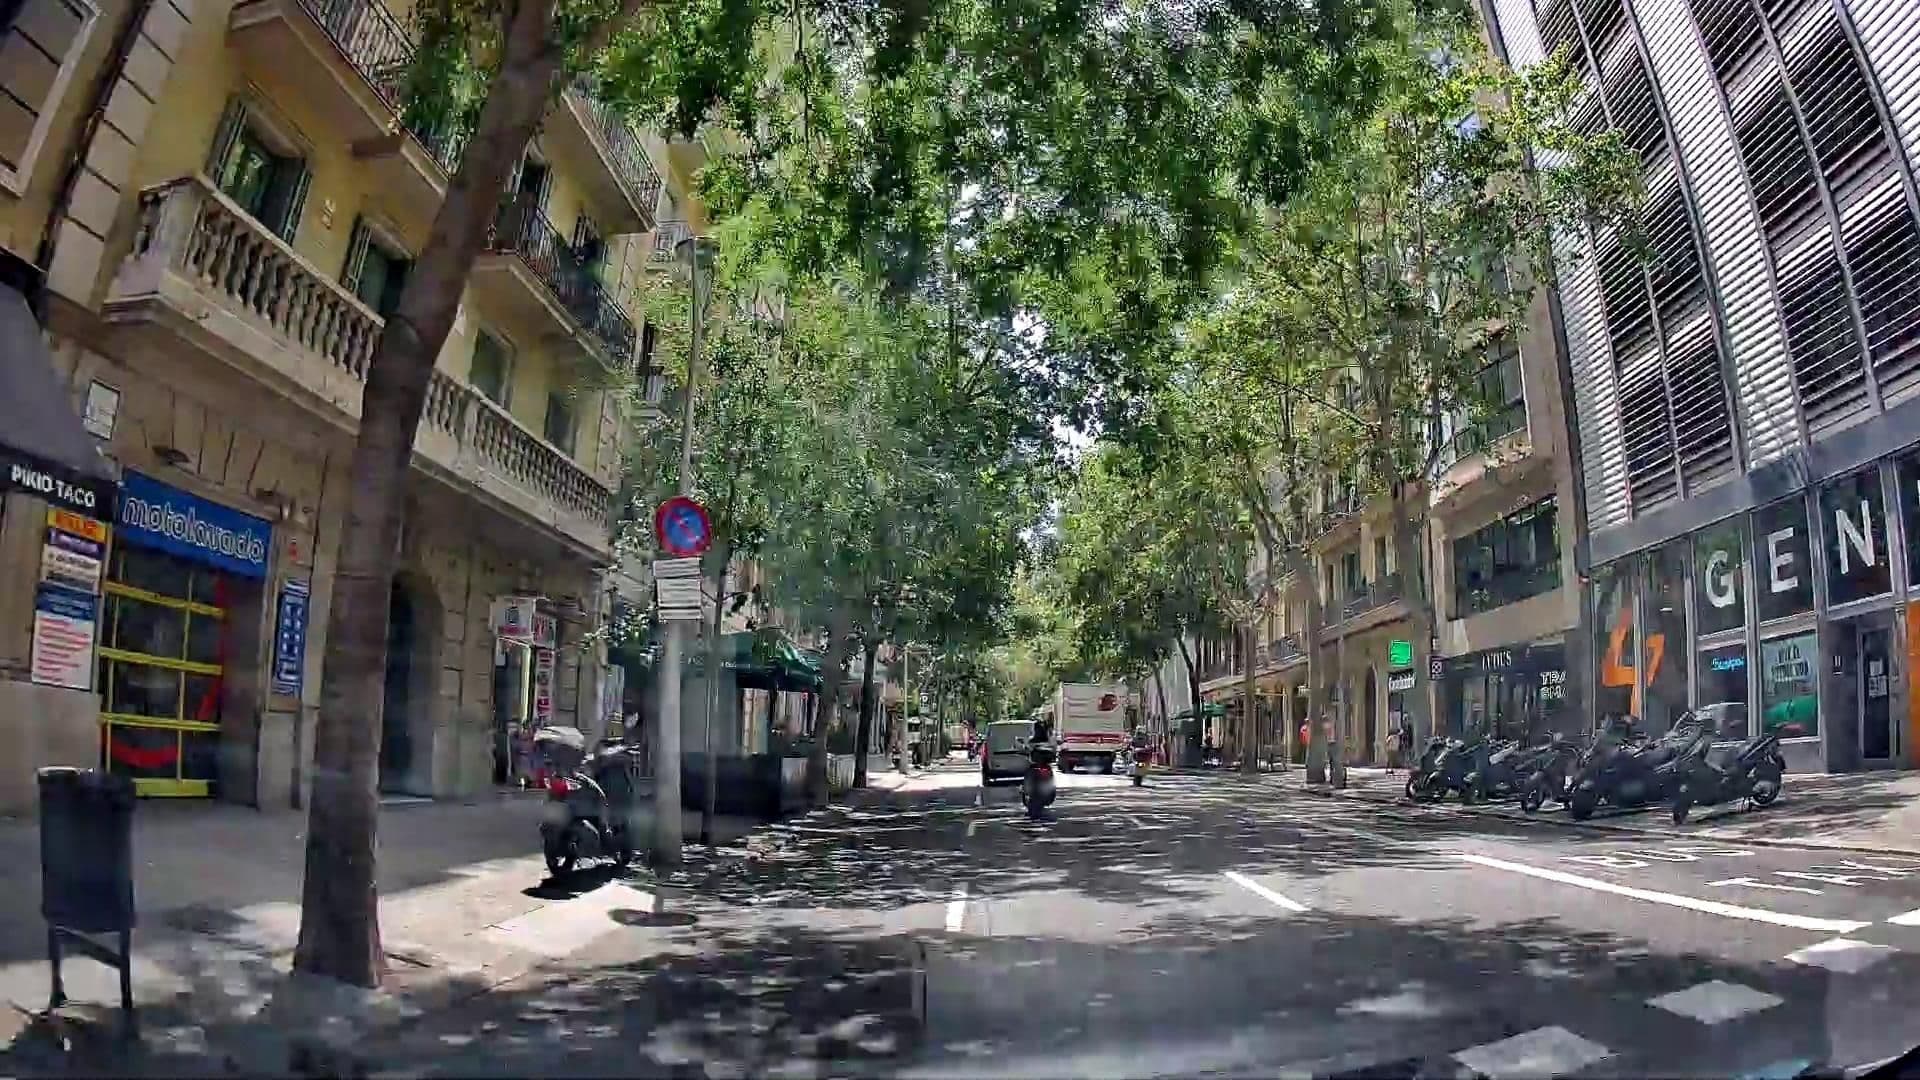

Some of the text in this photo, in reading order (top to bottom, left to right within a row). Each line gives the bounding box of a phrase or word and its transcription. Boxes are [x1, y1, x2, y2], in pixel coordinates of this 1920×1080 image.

[56, 480, 95, 507] TACO
[122, 497, 265, 563] motolavado
[1706, 480, 1920, 608] GEN
[1557, 846, 1756, 869] BUS
